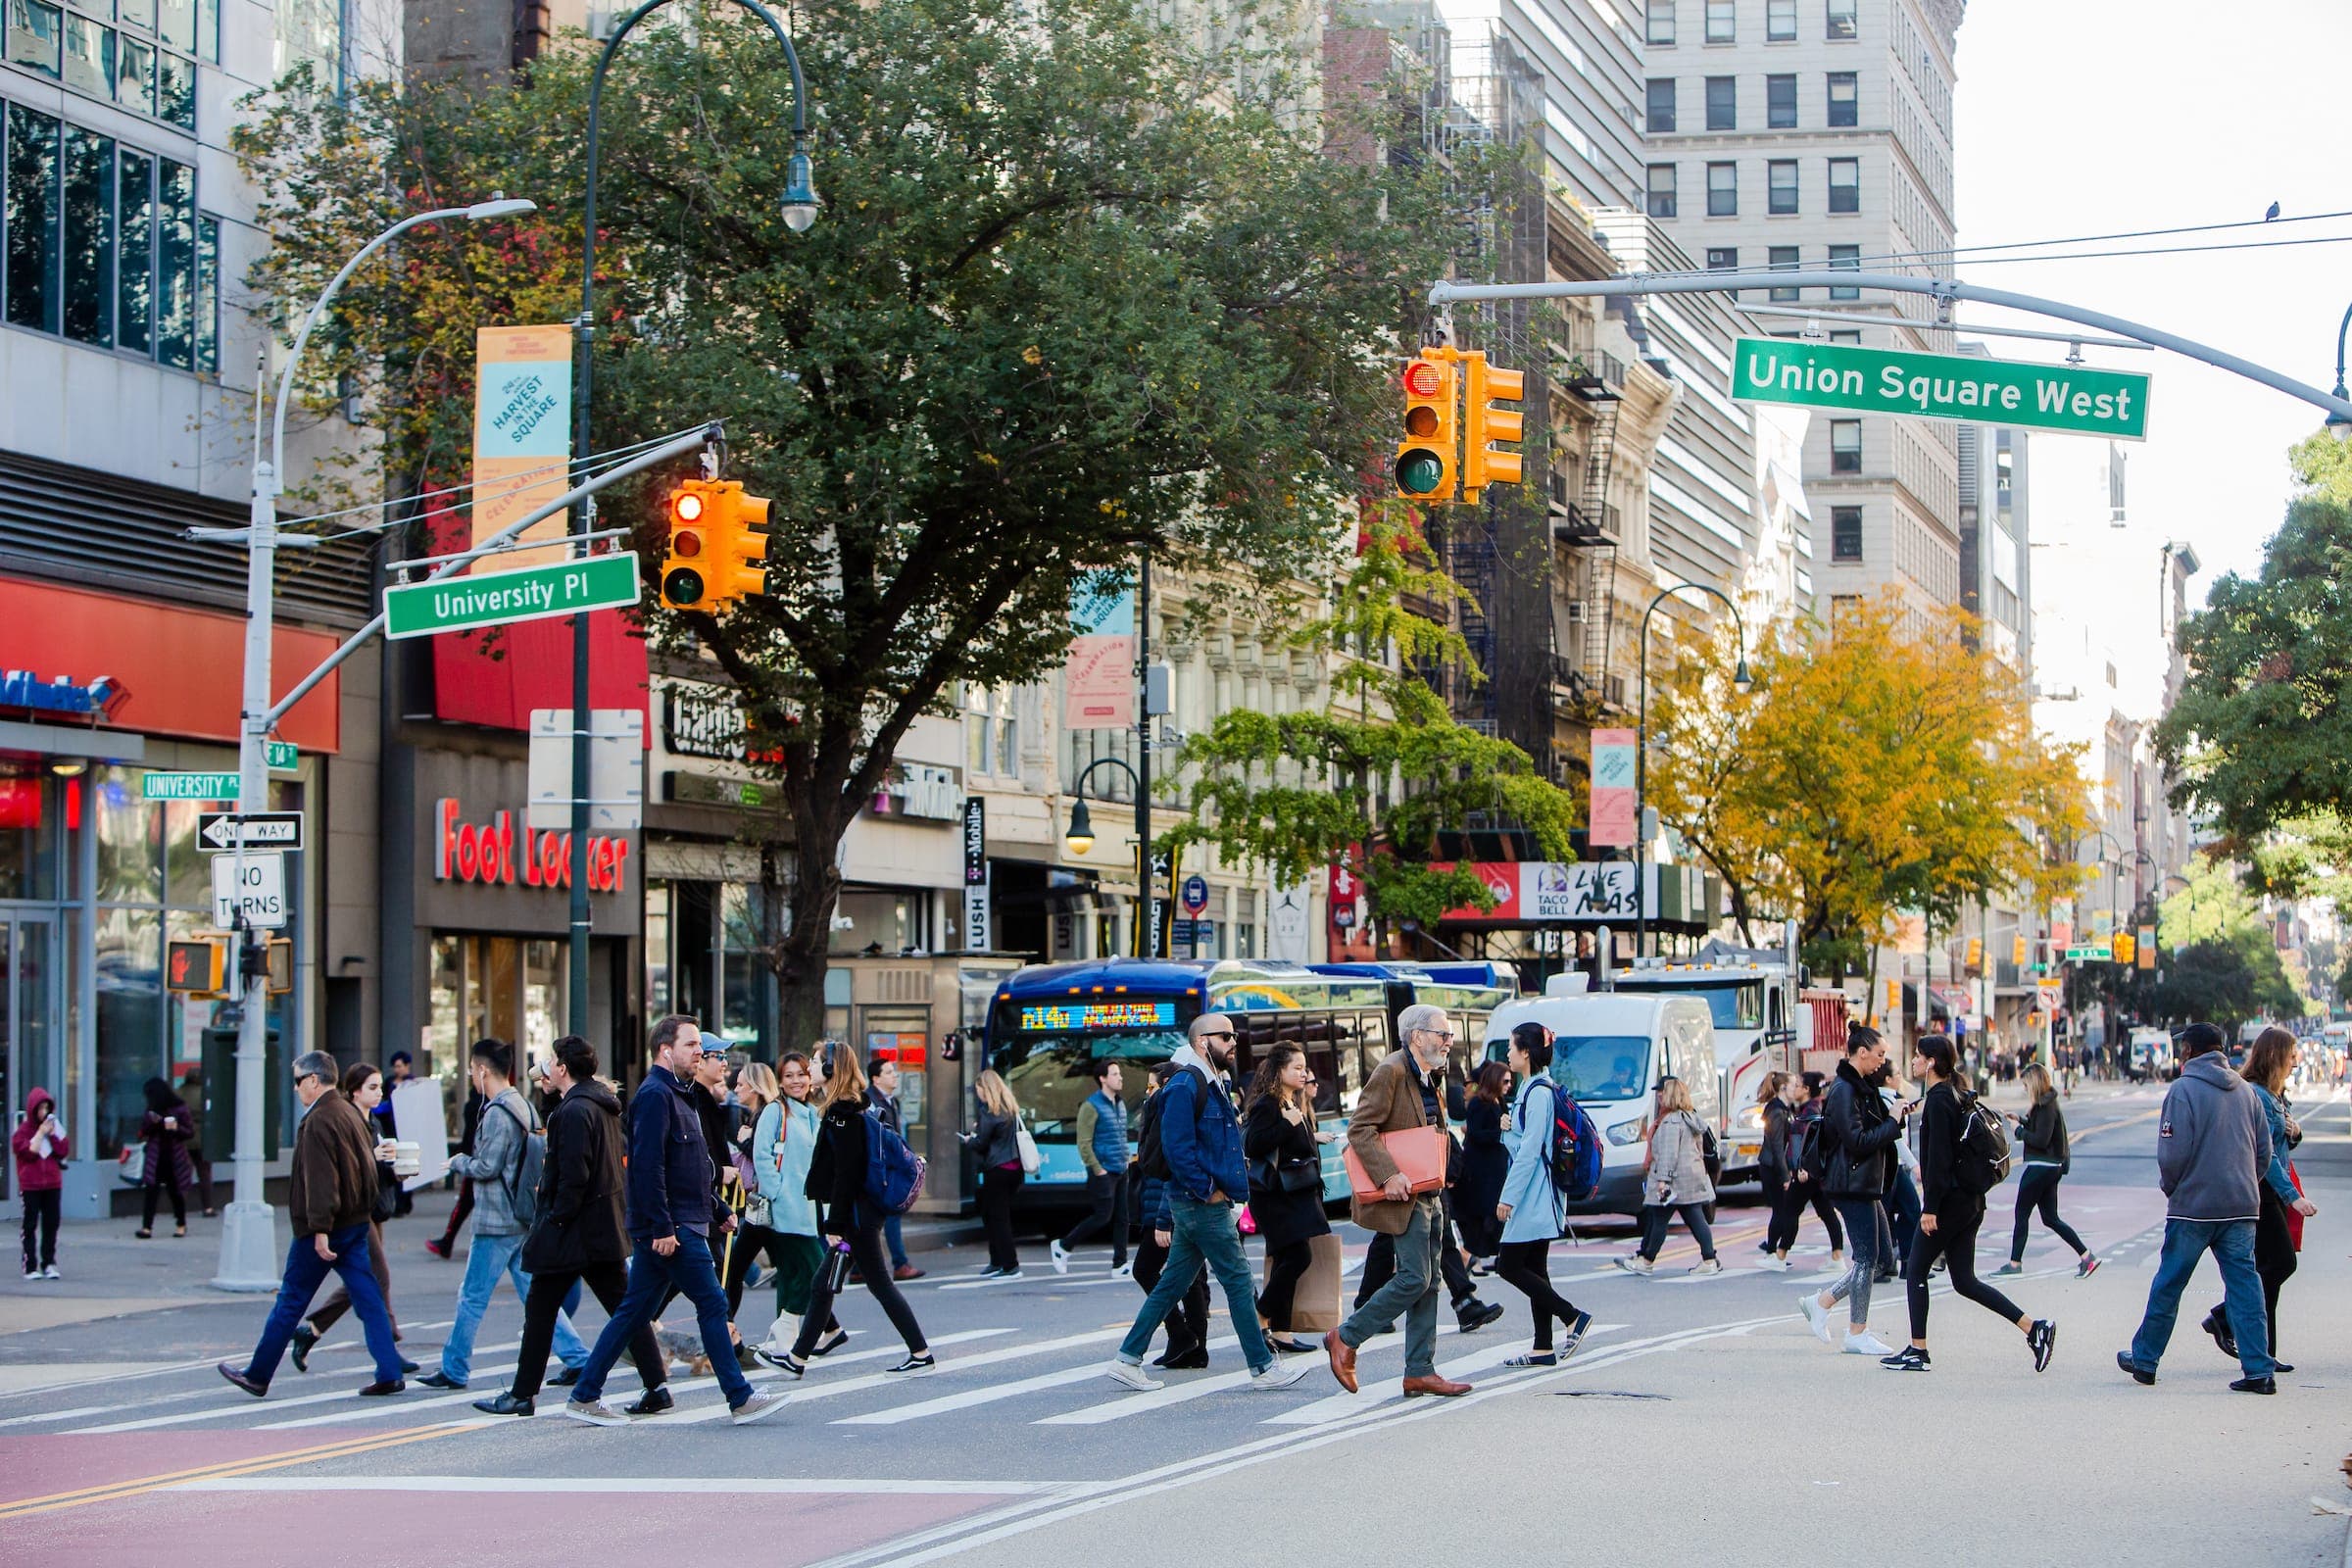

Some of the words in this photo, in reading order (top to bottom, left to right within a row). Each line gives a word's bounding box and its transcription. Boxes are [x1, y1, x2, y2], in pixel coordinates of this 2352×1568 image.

[493, 375, 543, 429] HARVEST
[1748, 354, 1864, 396] Union
[1879, 366, 2022, 410] Square
[2036, 379, 2131, 421] West
[512, 395, 558, 443] SQUARE
[513, 413, 524, 424] IN
[521, 398, 540, 415] THE
[434, 580, 555, 618] University
[565, 571, 588, 600] Pl
[1093, 594, 1125, 627] SQUARE
[147, 775, 223, 797] UNIVERSITY
[228, 776, 239, 788] PL
[258, 824, 288, 838] WAY
[436, 798, 514, 884] Foot
[1538, 895, 1568, 905] TACO
[1539, 906, 1567, 915] BELL
[971, 899, 984, 948] LUSH
